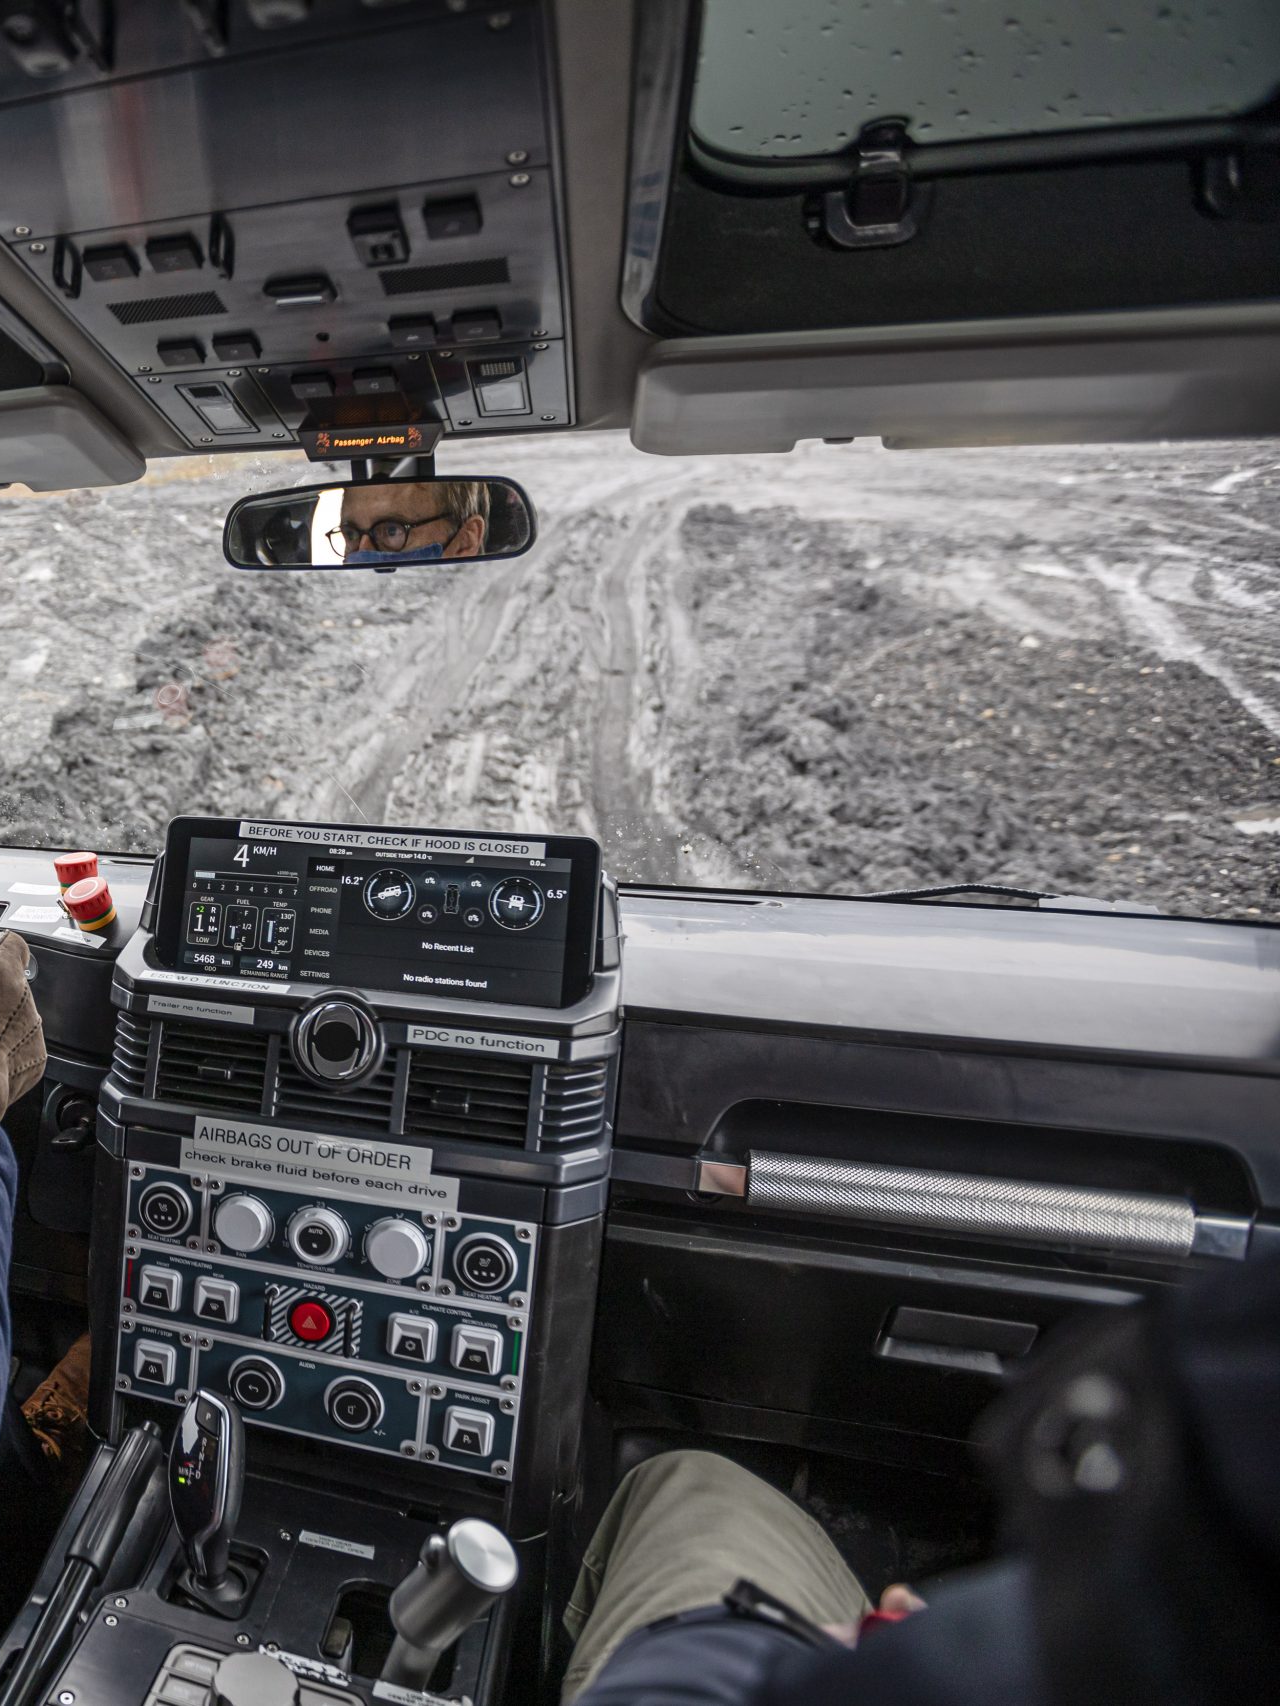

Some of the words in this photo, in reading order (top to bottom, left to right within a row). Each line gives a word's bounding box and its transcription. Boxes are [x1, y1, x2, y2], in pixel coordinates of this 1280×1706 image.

[334, 438, 373, 448] Passenger
[377, 436, 404, 444] Airbag
[249, 826, 292, 838] BEFORE
[297, 830, 320, 840] YOU
[323, 832, 364, 845] START,
[368, 836, 408, 847] CHECK
[412, 838, 421, 848] IF
[425, 839, 460, 850] HOOD
[464, 842, 475, 851] IS
[479, 842, 529, 854] CLOSED
[233, 844, 250, 867] 4
[253, 846, 277, 855] KM/H
[425, 876, 435, 885] 0%
[471, 880, 482, 888] 0%
[309, 885, 337, 893] OFFROAD
[422, 911, 432, 919] 0%
[468, 914, 479, 922] 0%
[194, 914, 204, 932] 1
[309, 928, 329, 936] MEDIA
[304, 949, 330, 957] DEVICES
[434, 943, 459, 952] Recent
[460, 945, 474, 953] List
[194, 954, 215, 964] 5468
[222, 958, 231, 966] km
[257, 960, 274, 969] 249
[240, 969, 269, 978] REMAINING
[300, 970, 330, 979] SETTINGS
[204, 978, 270, 991] FUNCTION
[403, 974, 414, 982] No
[415, 975, 433, 983] radio
[435, 977, 464, 986] stations
[465, 979, 488, 988] found
[152, 1000, 180, 1009] Trailer
[196, 1006, 233, 1016] function
[413, 1029, 450, 1042] PDC
[455, 1035, 475, 1045] no
[480, 1036, 545, 1052] function
[199, 1126, 272, 1150] AIRBAGS
[277, 1137, 313, 1155] OUT
[317, 1144, 341, 1159] OF
[347, 1147, 411, 1170] ORDER
[185, 1151, 226, 1164] check
[231, 1157, 272, 1171] brake
[276, 1163, 307, 1177] fluid
[312, 1169, 360, 1185] before
[365, 1179, 403, 1192] each
[408, 1185, 447, 1198] drive
[160, 1236, 181, 1244] HEATING
[170, 1256, 190, 1266] WINDOW
[191, 1260, 213, 1270] HEATING
[296, 1262, 336, 1274] TEMPERATURE
[304, 1283, 326, 1291] HAZARD
[477, 1292, 502, 1302] HEATING
[422, 1304, 445, 1314] CLIMATE
[446, 1308, 472, 1318] CONTROL
[142, 1326, 157, 1334] START
[299, 1361, 315, 1369] AUDIO
[206, 1412, 211, 1420] P
